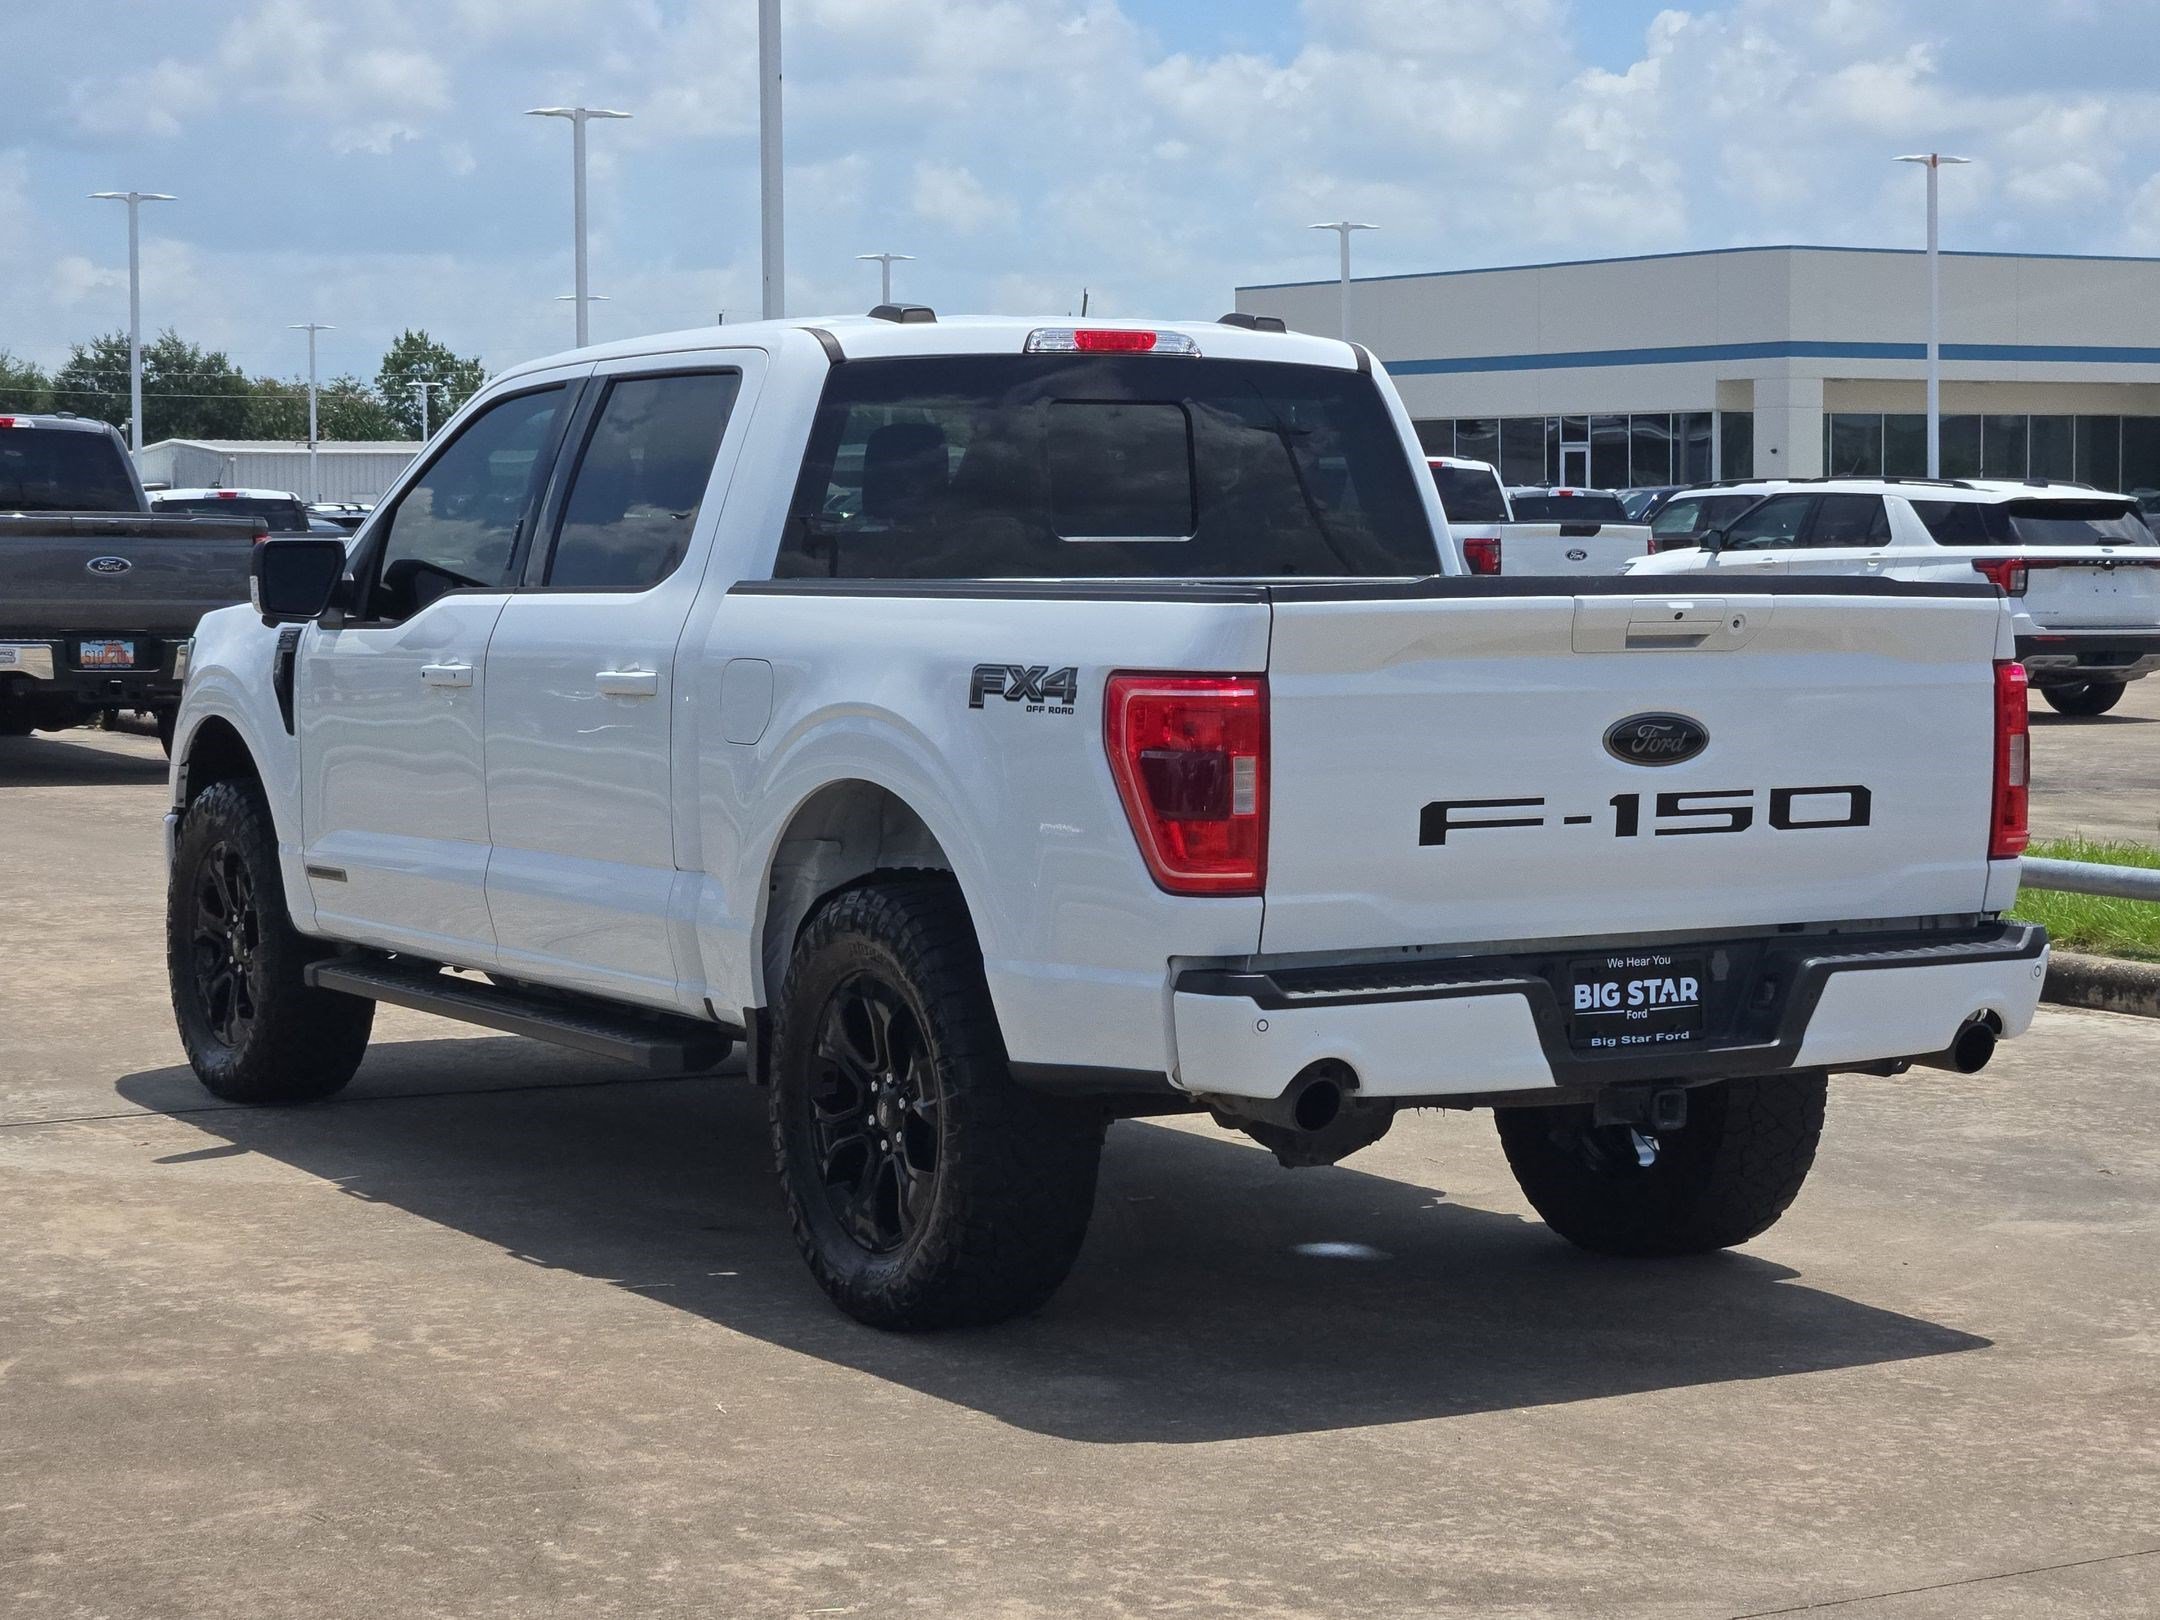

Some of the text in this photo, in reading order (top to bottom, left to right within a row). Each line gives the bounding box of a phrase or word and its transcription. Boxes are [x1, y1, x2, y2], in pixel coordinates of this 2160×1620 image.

[968, 663, 1079, 709] FX4
[1026, 705, 1075, 715] OFF ROAD
[1631, 724, 1688, 753] Ford
[1418, 784, 1872, 846] F-150
[1607, 955, 1671, 969] We Hear You
[1574, 977, 1699, 1010] BIG STAR
[1626, 1009, 1648, 1020] Ford
[1591, 1031, 1690, 1047] Big Star Ford
